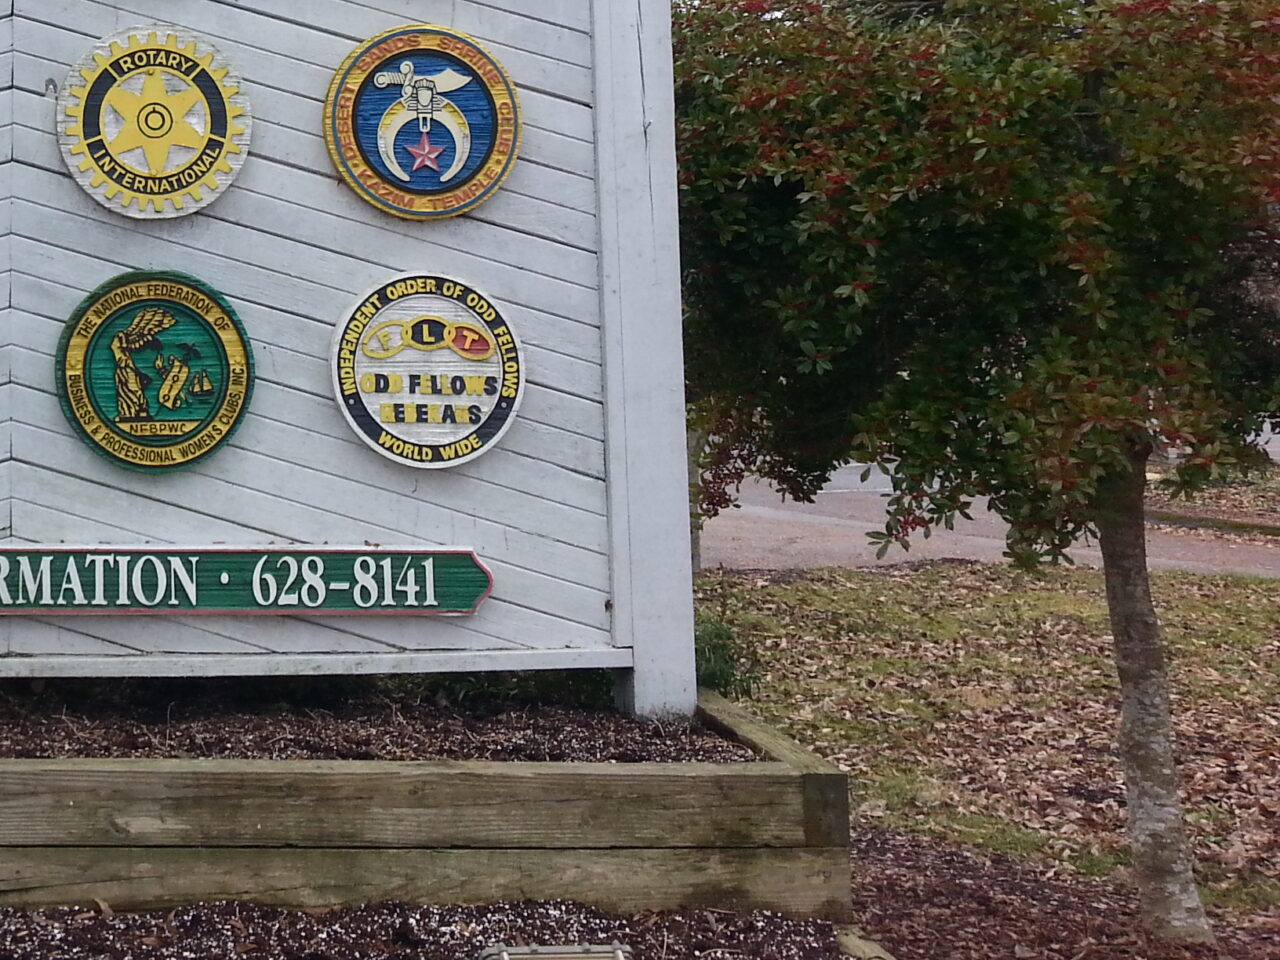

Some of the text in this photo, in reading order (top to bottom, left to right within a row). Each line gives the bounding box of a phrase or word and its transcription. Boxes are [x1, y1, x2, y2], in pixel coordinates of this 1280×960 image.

[119, 51, 194, 73] ROTARY
[337, 34, 513, 160] DESERT SANDS SHRINE CLUB
[94, 148, 219, 192] INTERNATIONAL
[357, 166, 498, 209] KAZIM TEMPLE
[77, 284, 232, 339] THE NATIONAL FEDERATION OF
[340, 279, 518, 398] INDEPENDENT ORDER OF ODD FELLOWS
[376, 324, 479, 350] F L T
[360, 374, 498, 395] ODD FELLOWS
[70, 374, 94, 425] BUSINESS
[91, 426, 100, 435] &
[101, 432, 176, 462] PROFESSIONAL
[130, 424, 186, 433] NFBPWC
[379, 432, 482, 461] WORLD WIDE
[252, 554, 438, 608] 628-8141
